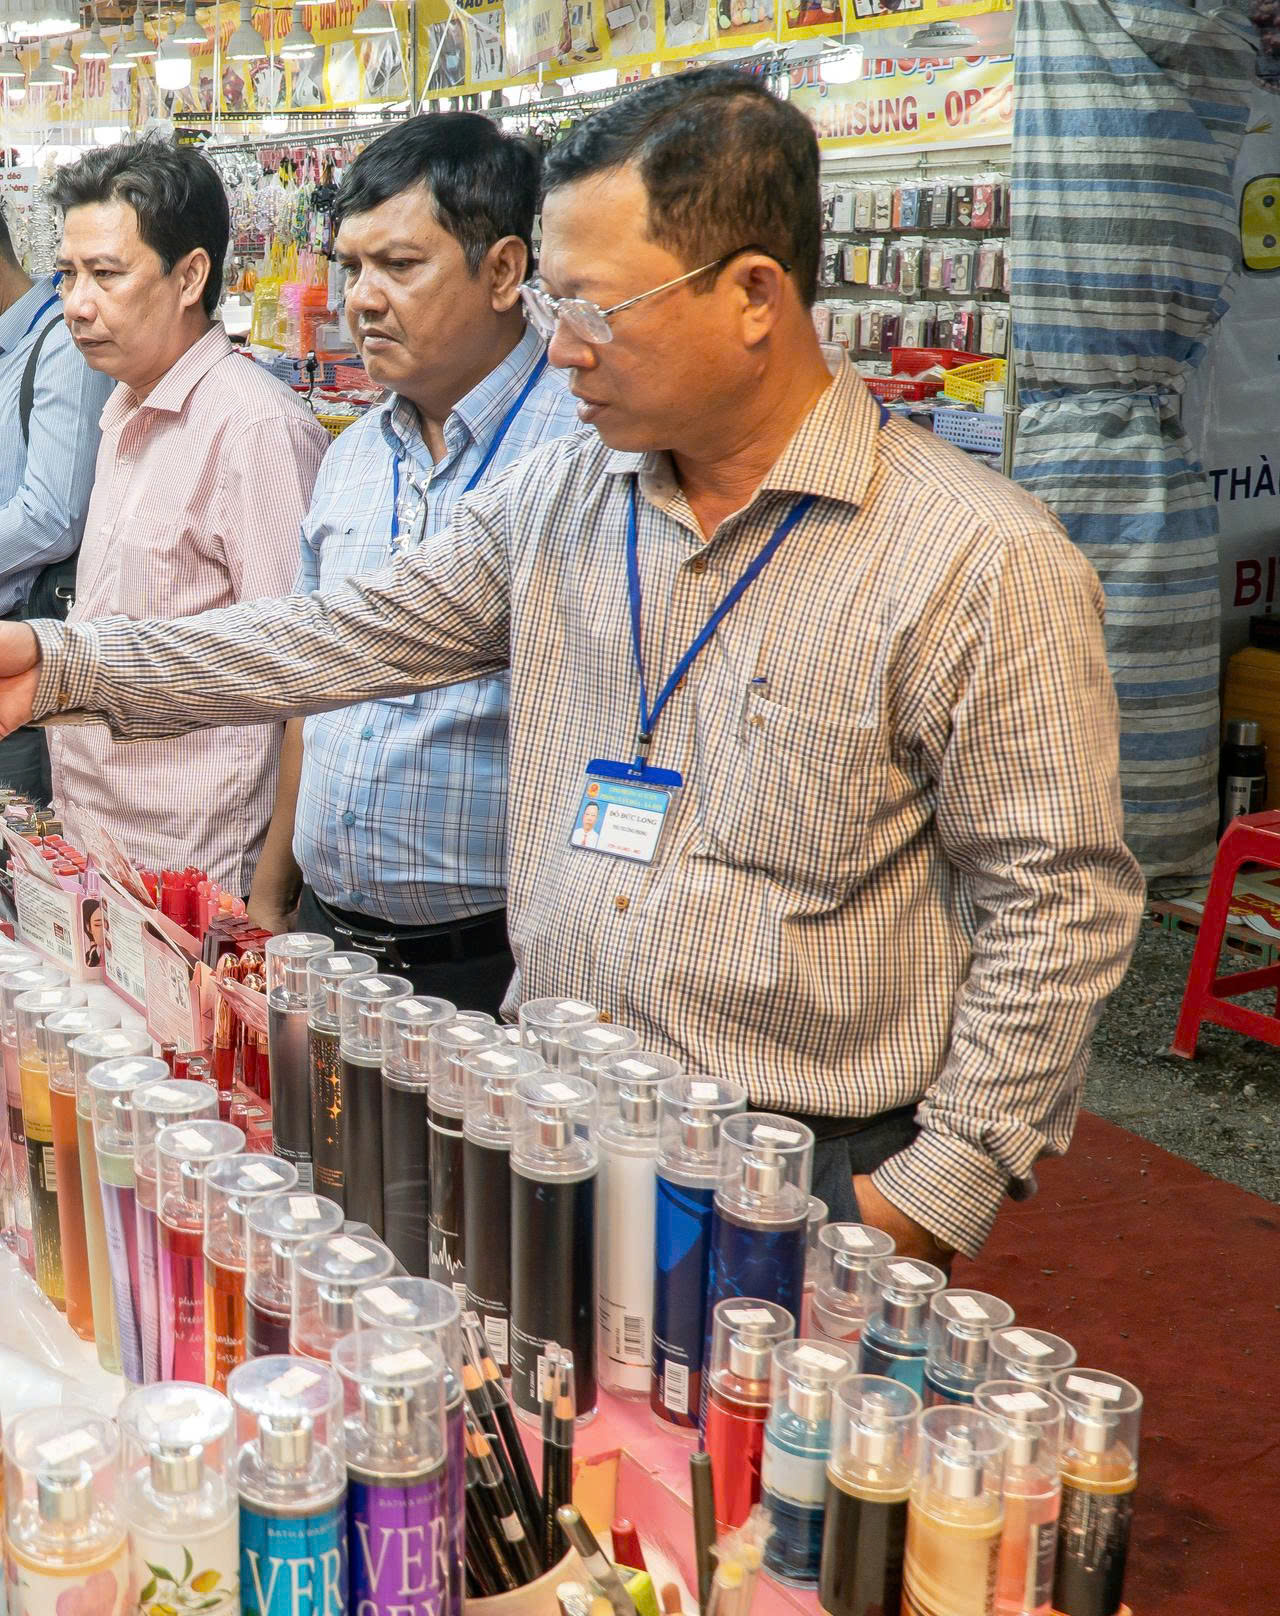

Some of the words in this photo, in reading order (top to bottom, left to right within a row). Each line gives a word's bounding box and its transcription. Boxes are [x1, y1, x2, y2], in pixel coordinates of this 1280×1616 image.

[1209, 454, 1280, 502] THÀ
[1233, 555, 1280, 613] BỊ
[246, 1547, 348, 1616] VER
[355, 1515, 450, 1596] VER
